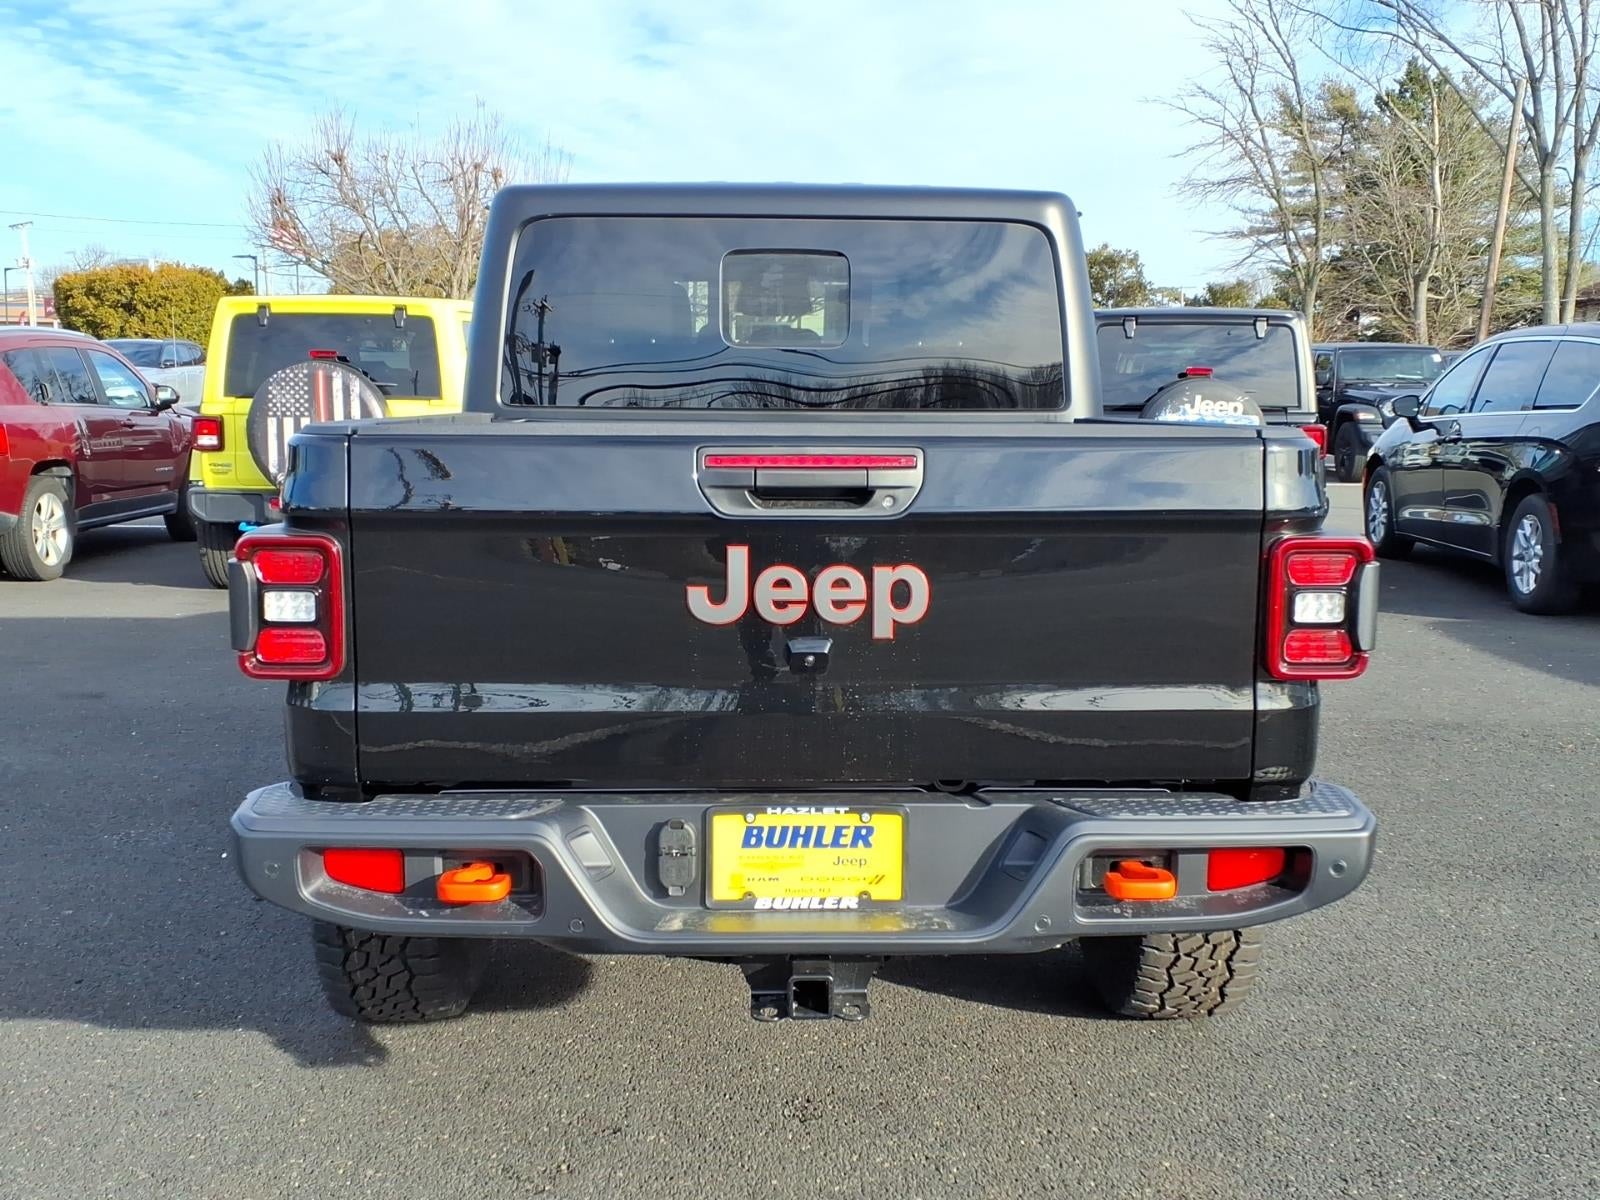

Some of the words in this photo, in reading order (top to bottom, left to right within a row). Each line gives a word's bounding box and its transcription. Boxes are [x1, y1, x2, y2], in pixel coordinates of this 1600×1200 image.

[1184, 395, 1244, 417] Jeep
[686, 544, 931, 640] Jeep
[766, 807, 850, 815] HAZLET
[741, 825, 875, 849] BUHLER
[833, 856, 868, 868] Jeep
[754, 896, 860, 909] BUHLER
